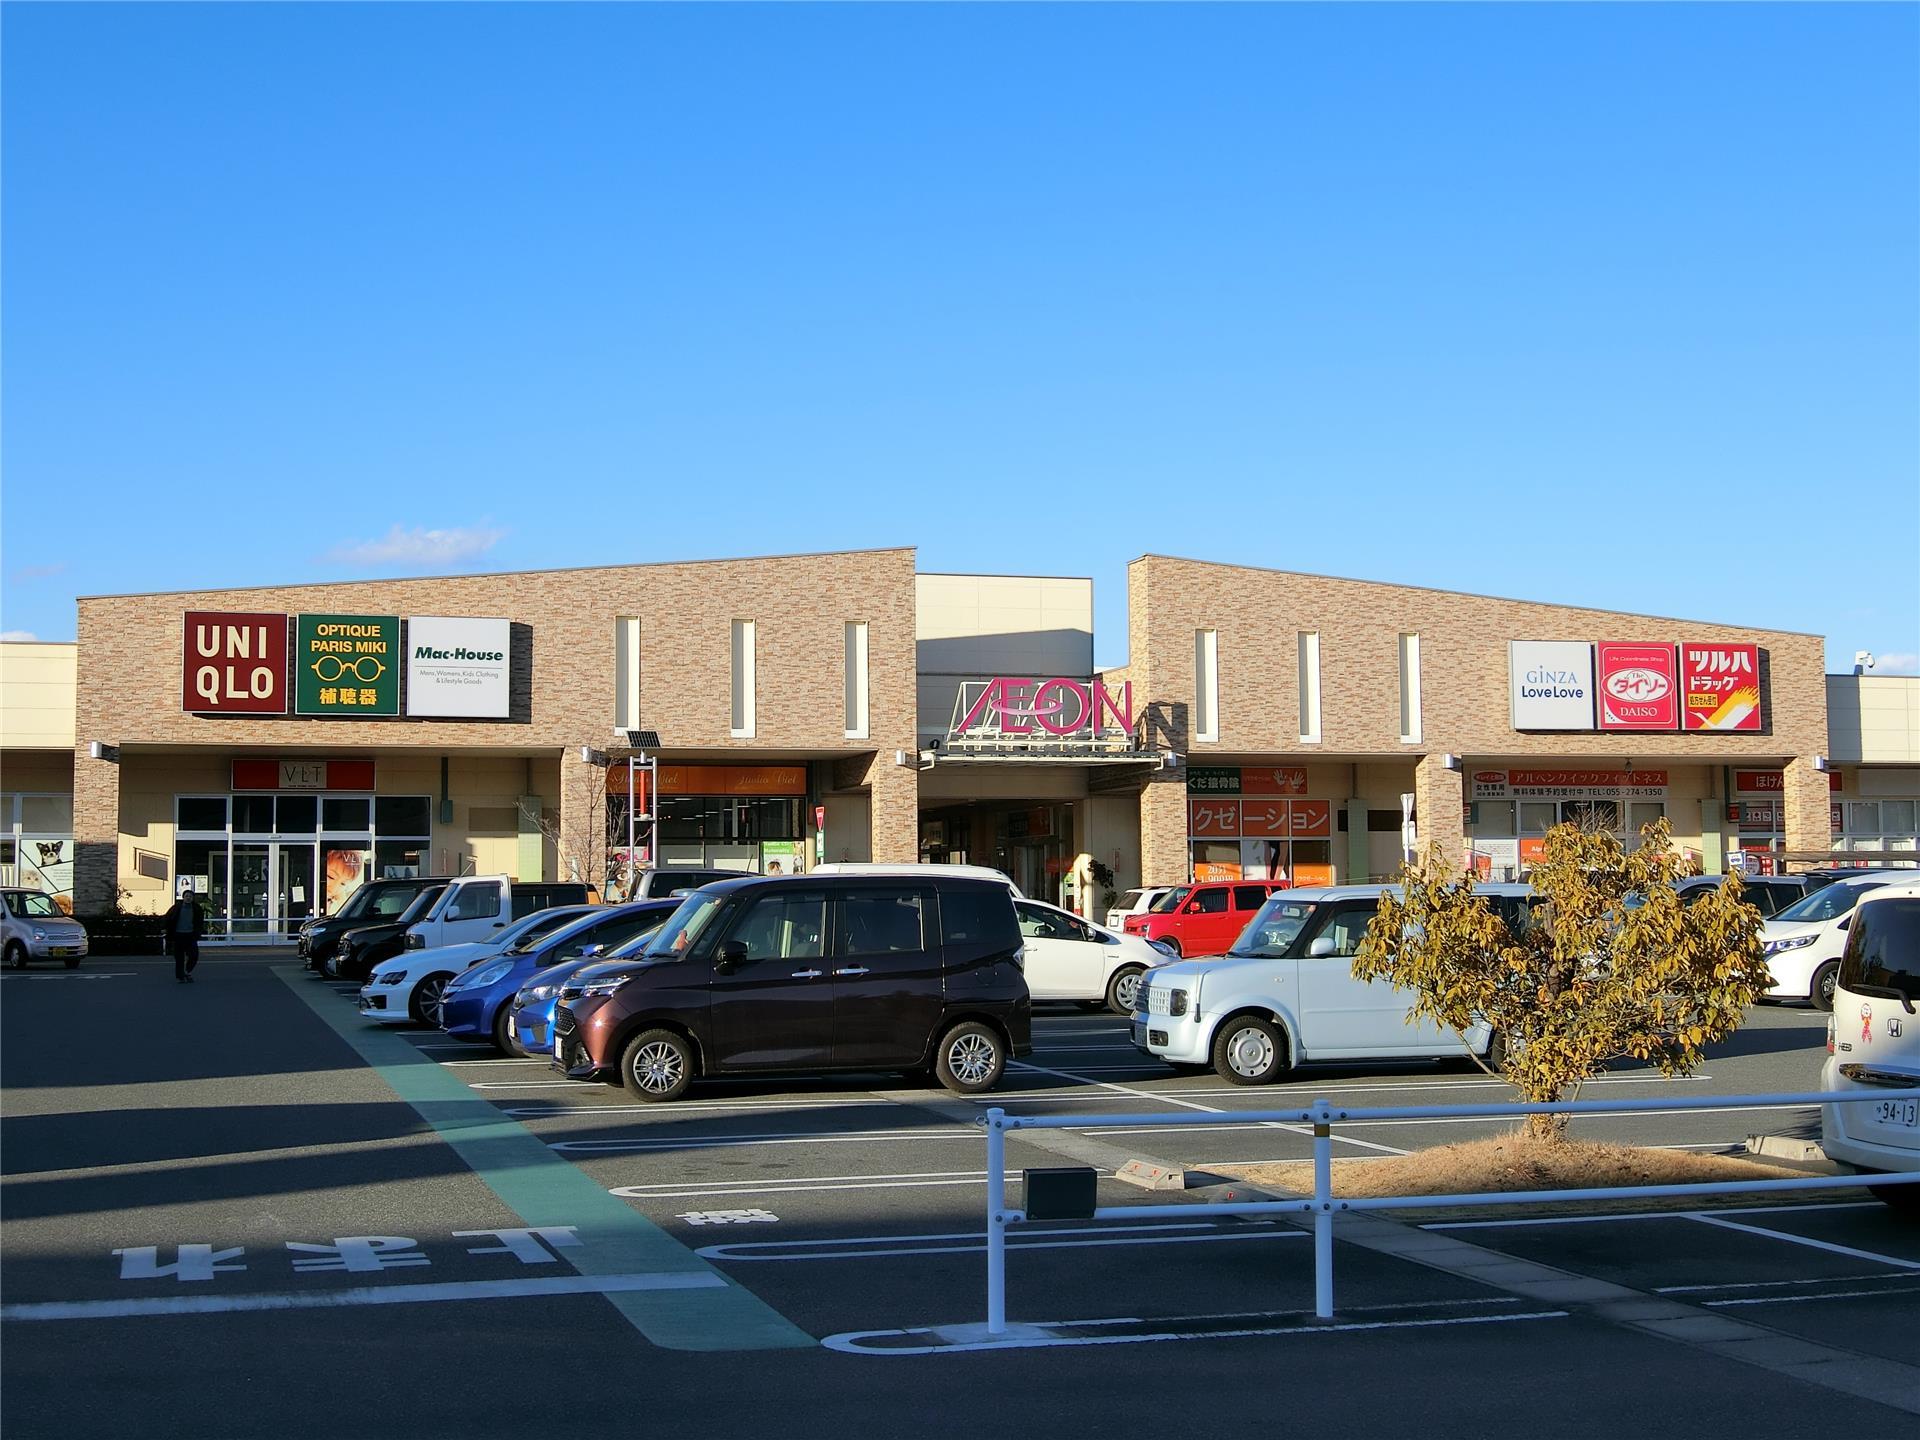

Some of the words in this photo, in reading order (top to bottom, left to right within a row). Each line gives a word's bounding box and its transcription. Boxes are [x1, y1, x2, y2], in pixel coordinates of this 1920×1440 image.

[317, 624, 381, 637] OPTIQUE
[197, 625, 267, 659] UNI
[311, 640, 353, 652] PARIS
[355, 641, 387, 653] MIKI
[1688, 650, 1752, 673] ツルハ
[475, 671, 499, 679] Clothing
[1690, 676, 1739, 691] ドラッグ
[196, 665, 274, 705] QLO
[1614, 677, 1666, 694] ダイソー
[320, 688, 377, 705] 補聴器
[1620, 706, 1658, 717] DAISO
[284, 766, 322, 783] VLT
[1195, 806, 1328, 831] クゼーション
